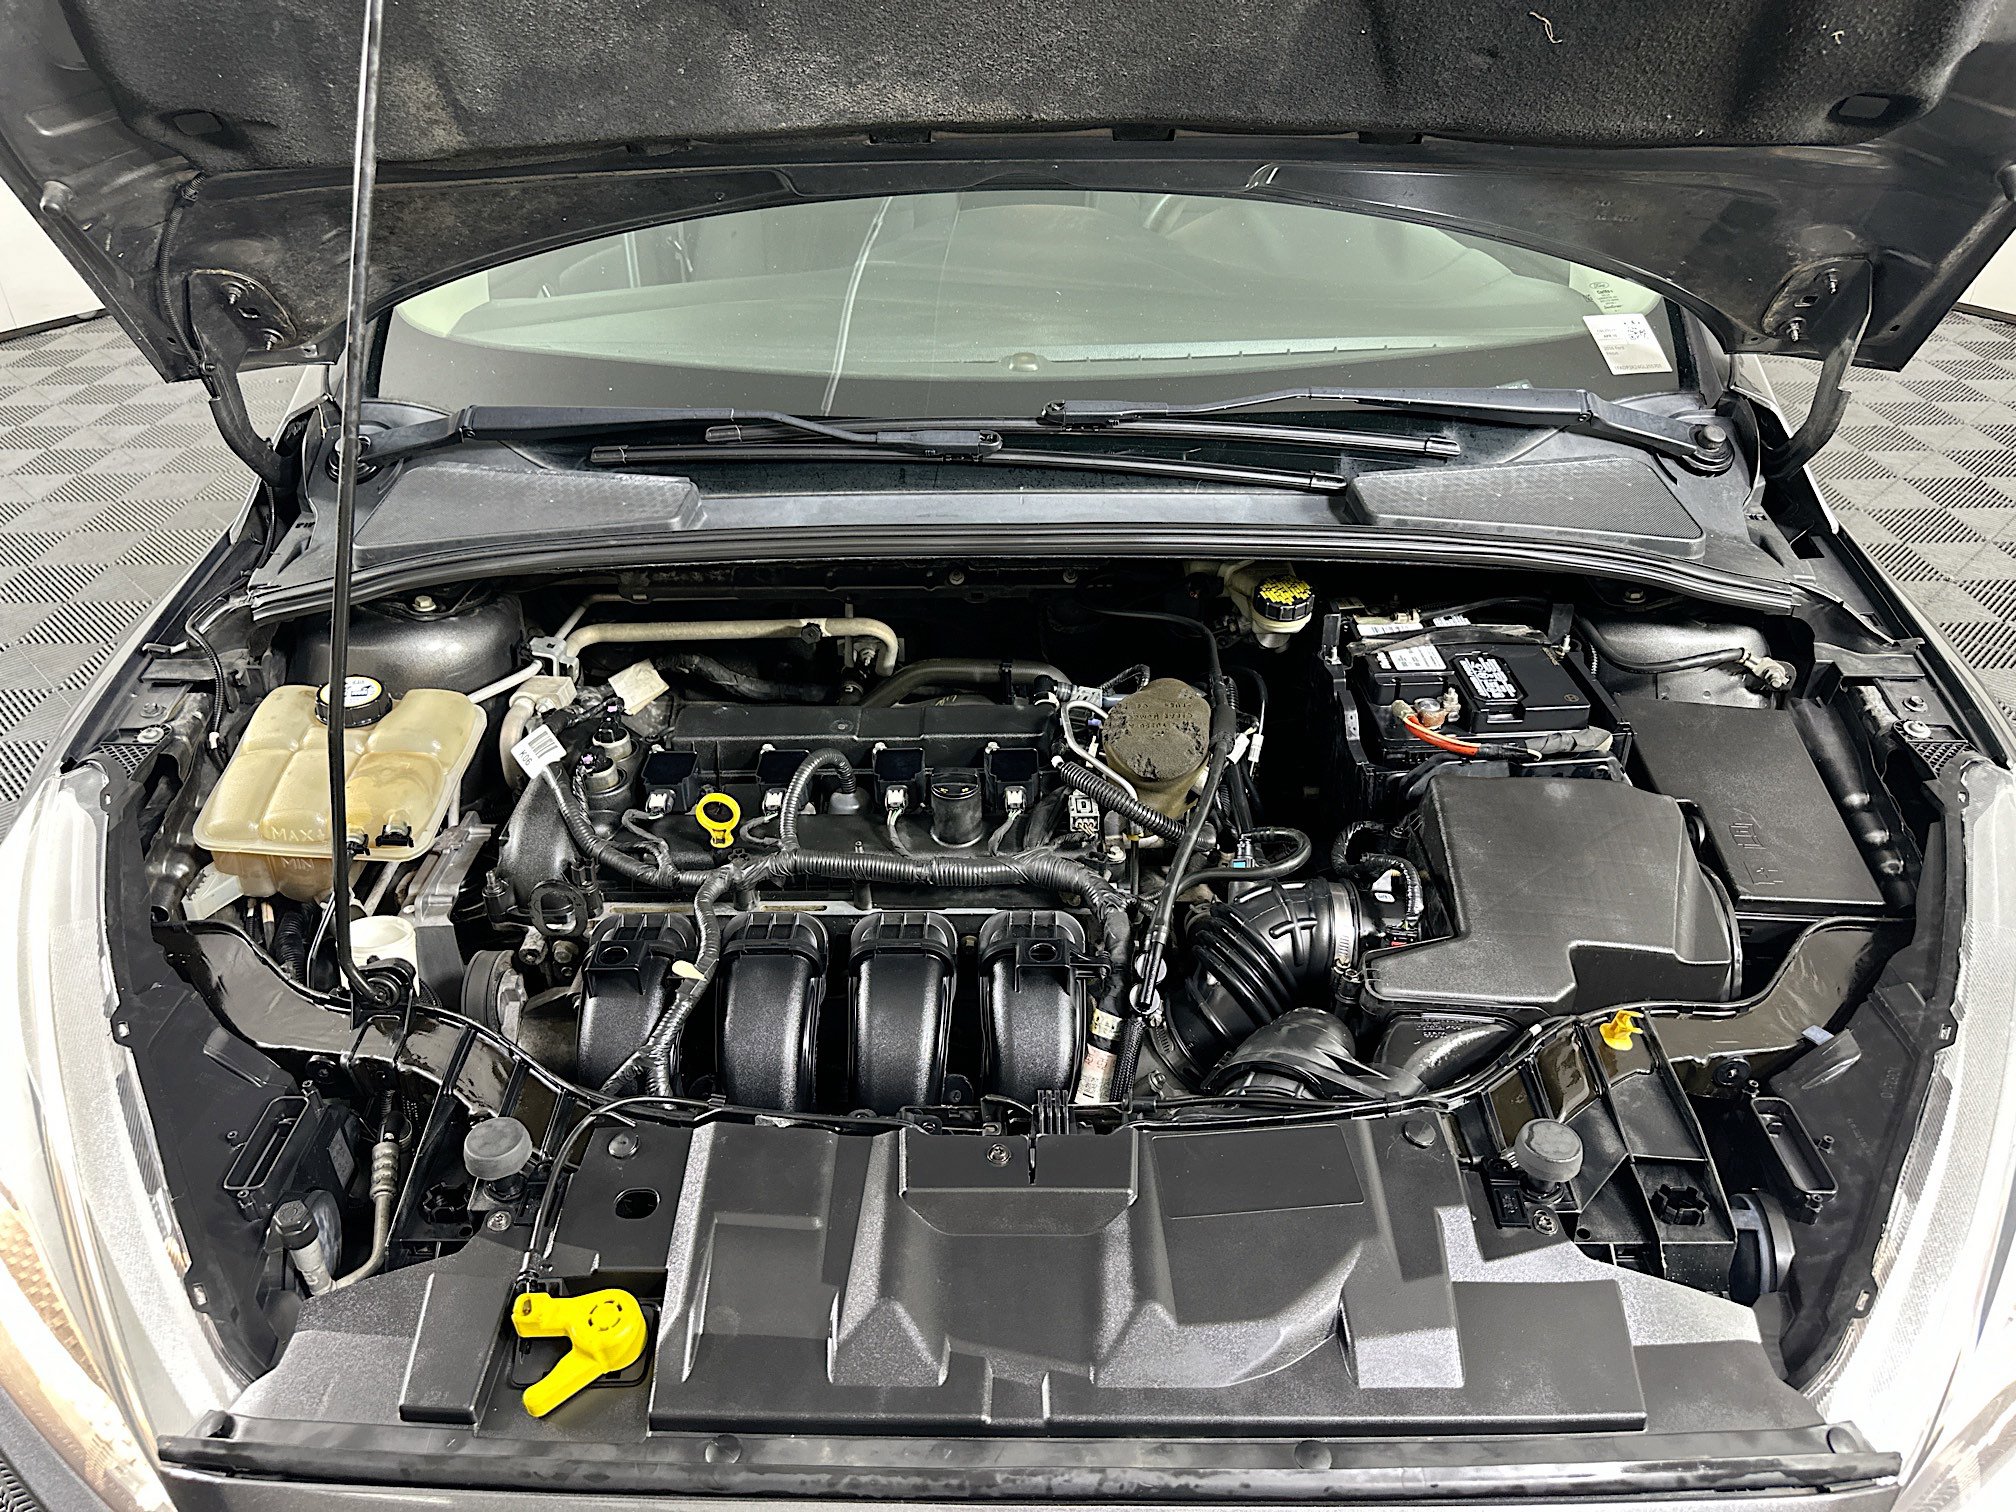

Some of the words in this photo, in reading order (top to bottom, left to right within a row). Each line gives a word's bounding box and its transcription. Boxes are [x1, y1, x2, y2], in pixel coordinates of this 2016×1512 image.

[519, 749, 533, 766] K06
[271, 826, 314, 841] MAX
[280, 857, 314, 871] MIN
